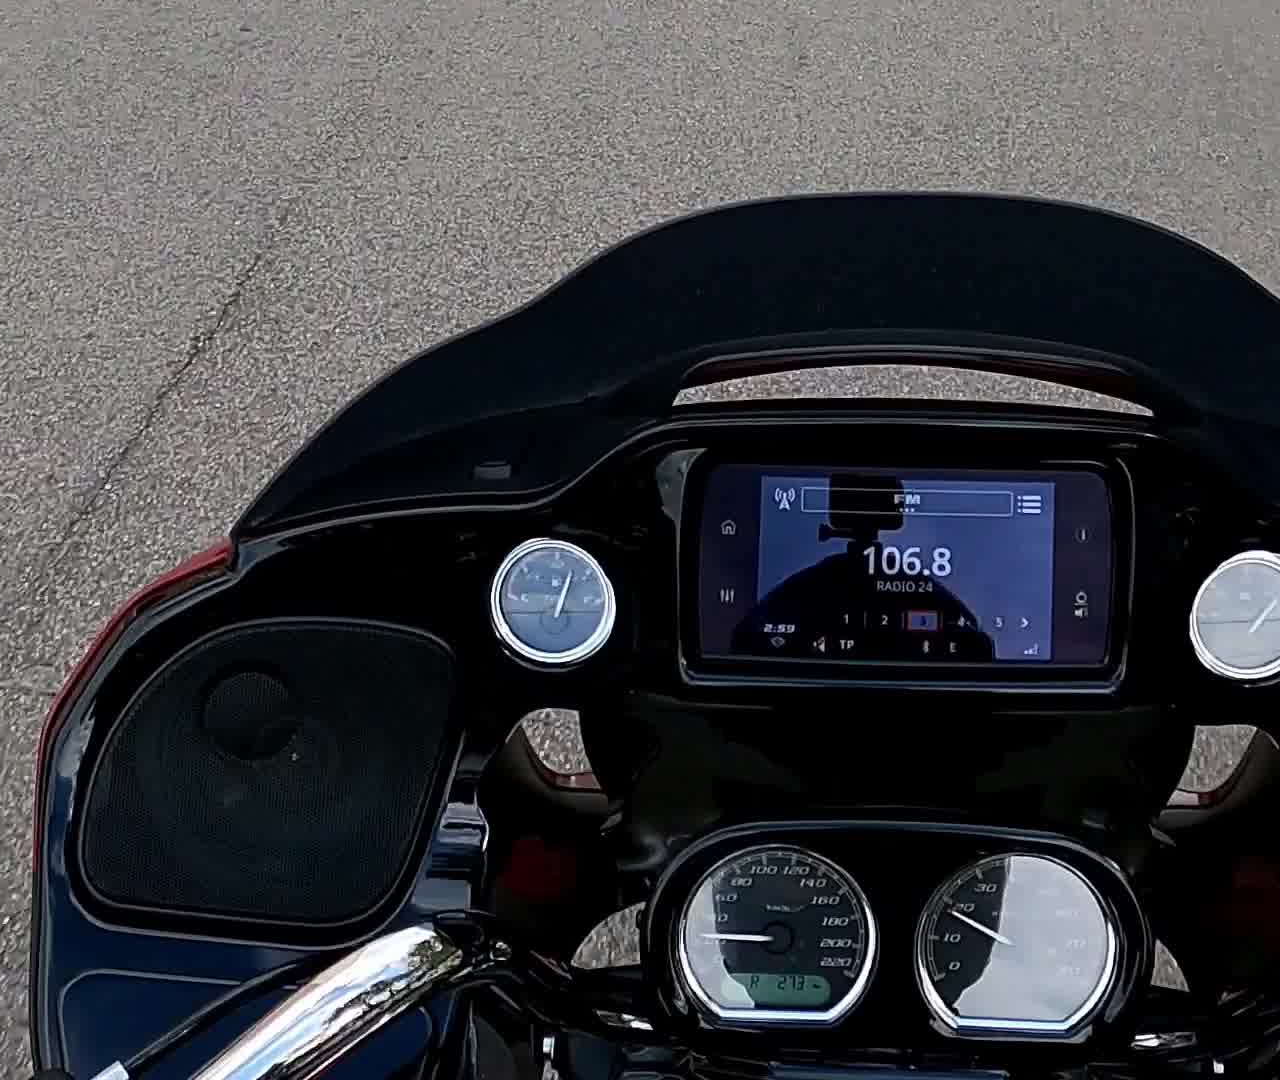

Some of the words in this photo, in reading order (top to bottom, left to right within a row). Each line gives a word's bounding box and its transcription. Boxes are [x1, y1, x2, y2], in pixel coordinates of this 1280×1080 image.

[894, 494, 921, 506] FM
[863, 546, 952, 577] 106.8
[876, 581, 915, 593] RADIO
[918, 582, 933, 593] 24
[842, 614, 849, 624] 1
[881, 615, 888, 625] 2
[839, 640, 854, 650] TP
[751, 865, 778, 874] 100
[783, 865, 810, 875] 120
[731, 878, 752, 887] 80
[800, 879, 827, 888] 140
[974, 883, 998, 893] 30
[809, 896, 840, 905] 160
[822, 917, 849, 926] 180
[820, 938, 852, 948] 200
[943, 933, 961, 943] 10
[820, 958, 852, 967] 220
[948, 961, 961, 970] 0
